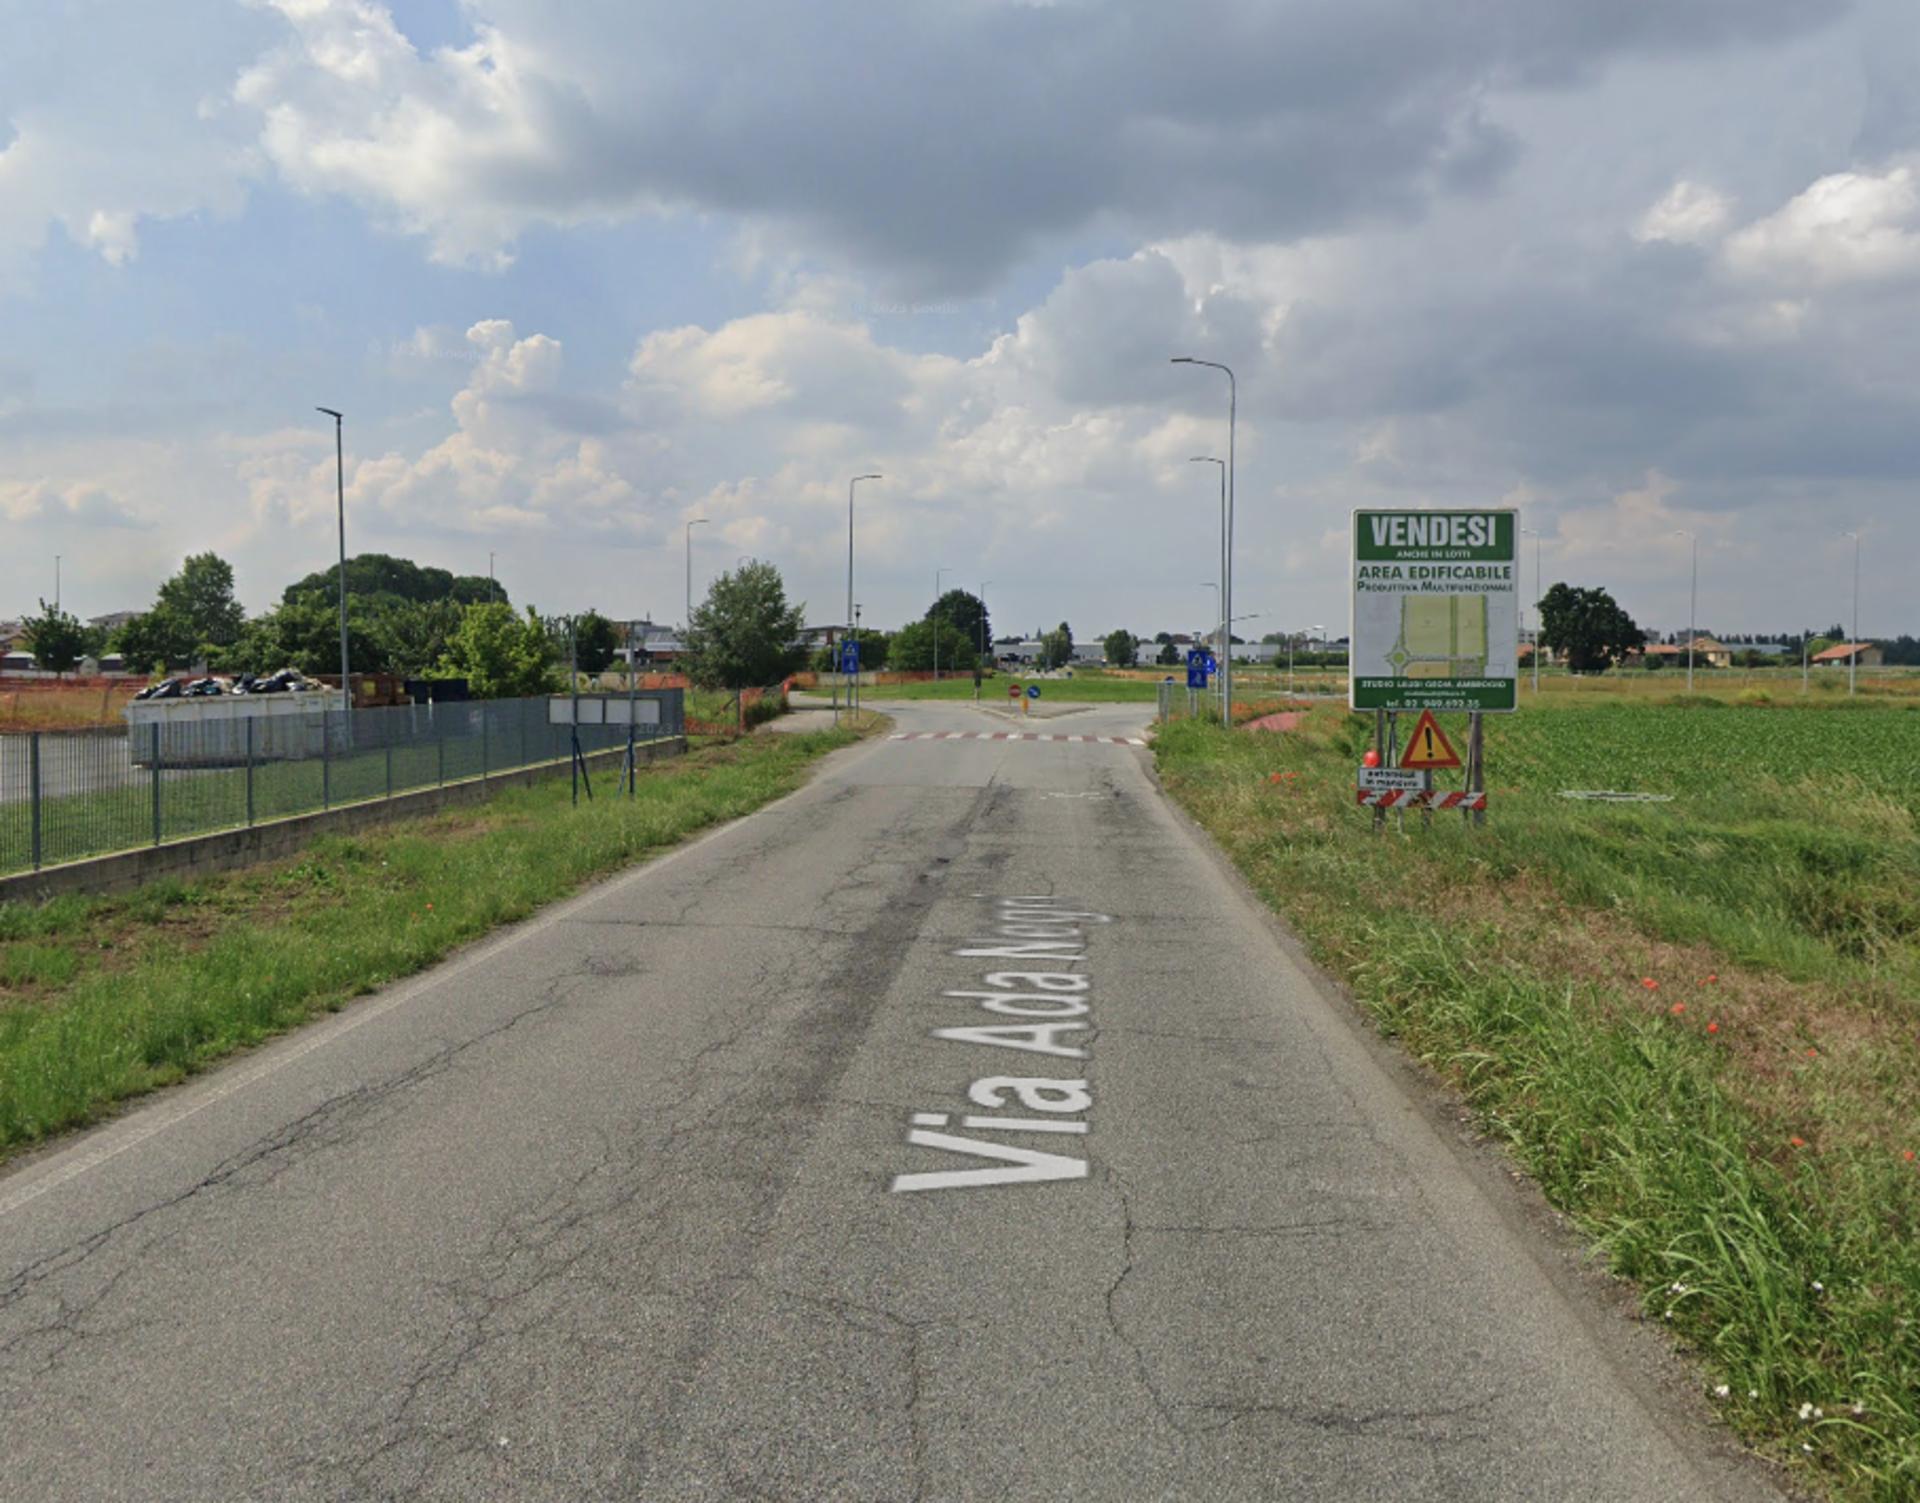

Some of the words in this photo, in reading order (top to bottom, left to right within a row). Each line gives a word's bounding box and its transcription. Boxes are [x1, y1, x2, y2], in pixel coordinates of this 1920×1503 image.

[1371, 515, 1496, 547] VENDESI
[1396, 550, 1430, 559] ANCHE
[1431, 550, 1443, 559] IN
[1445, 550, 1471, 559] LOTTI
[1358, 566, 1402, 579] AREA
[1409, 566, 1511, 580] EDIFICABILE
